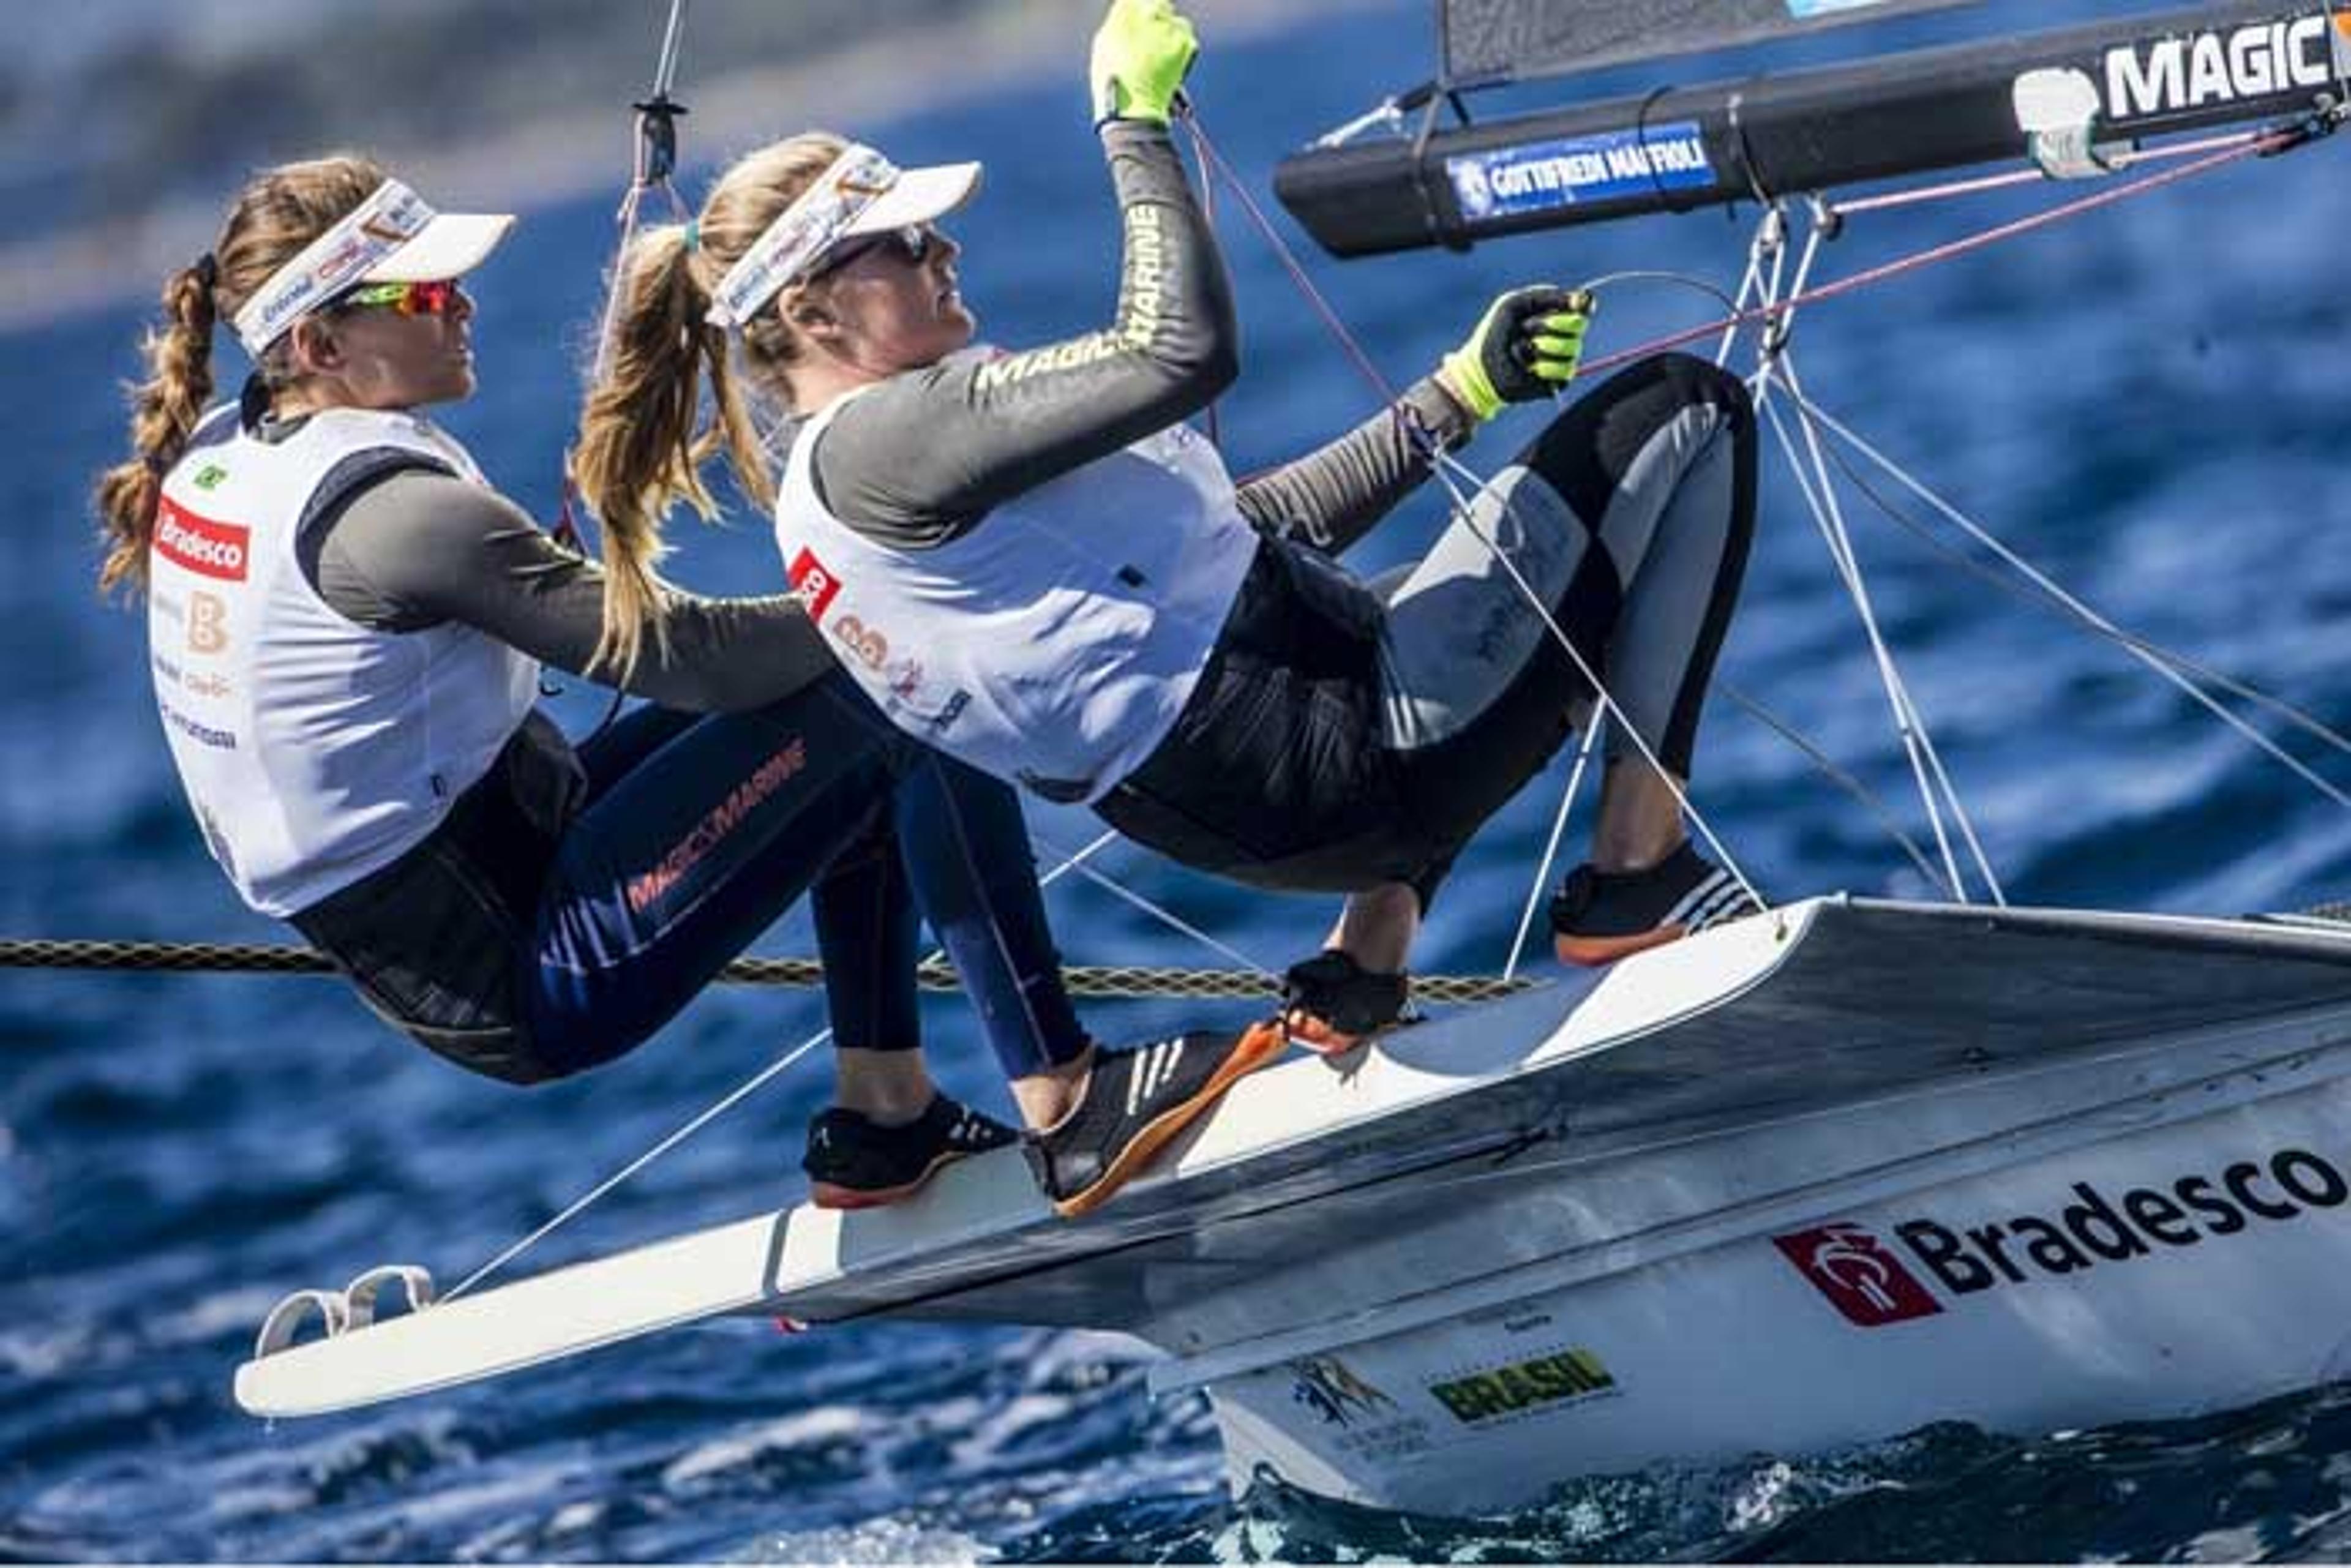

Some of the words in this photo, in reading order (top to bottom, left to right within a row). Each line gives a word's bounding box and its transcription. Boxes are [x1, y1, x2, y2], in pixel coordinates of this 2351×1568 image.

[2105, 16, 2328, 119] MAGIC
[1124, 204, 1161, 347] MARINE
[1894, 1149, 2349, 1295] Bradesco
[1430, 1350, 1614, 1424] BRASIL
